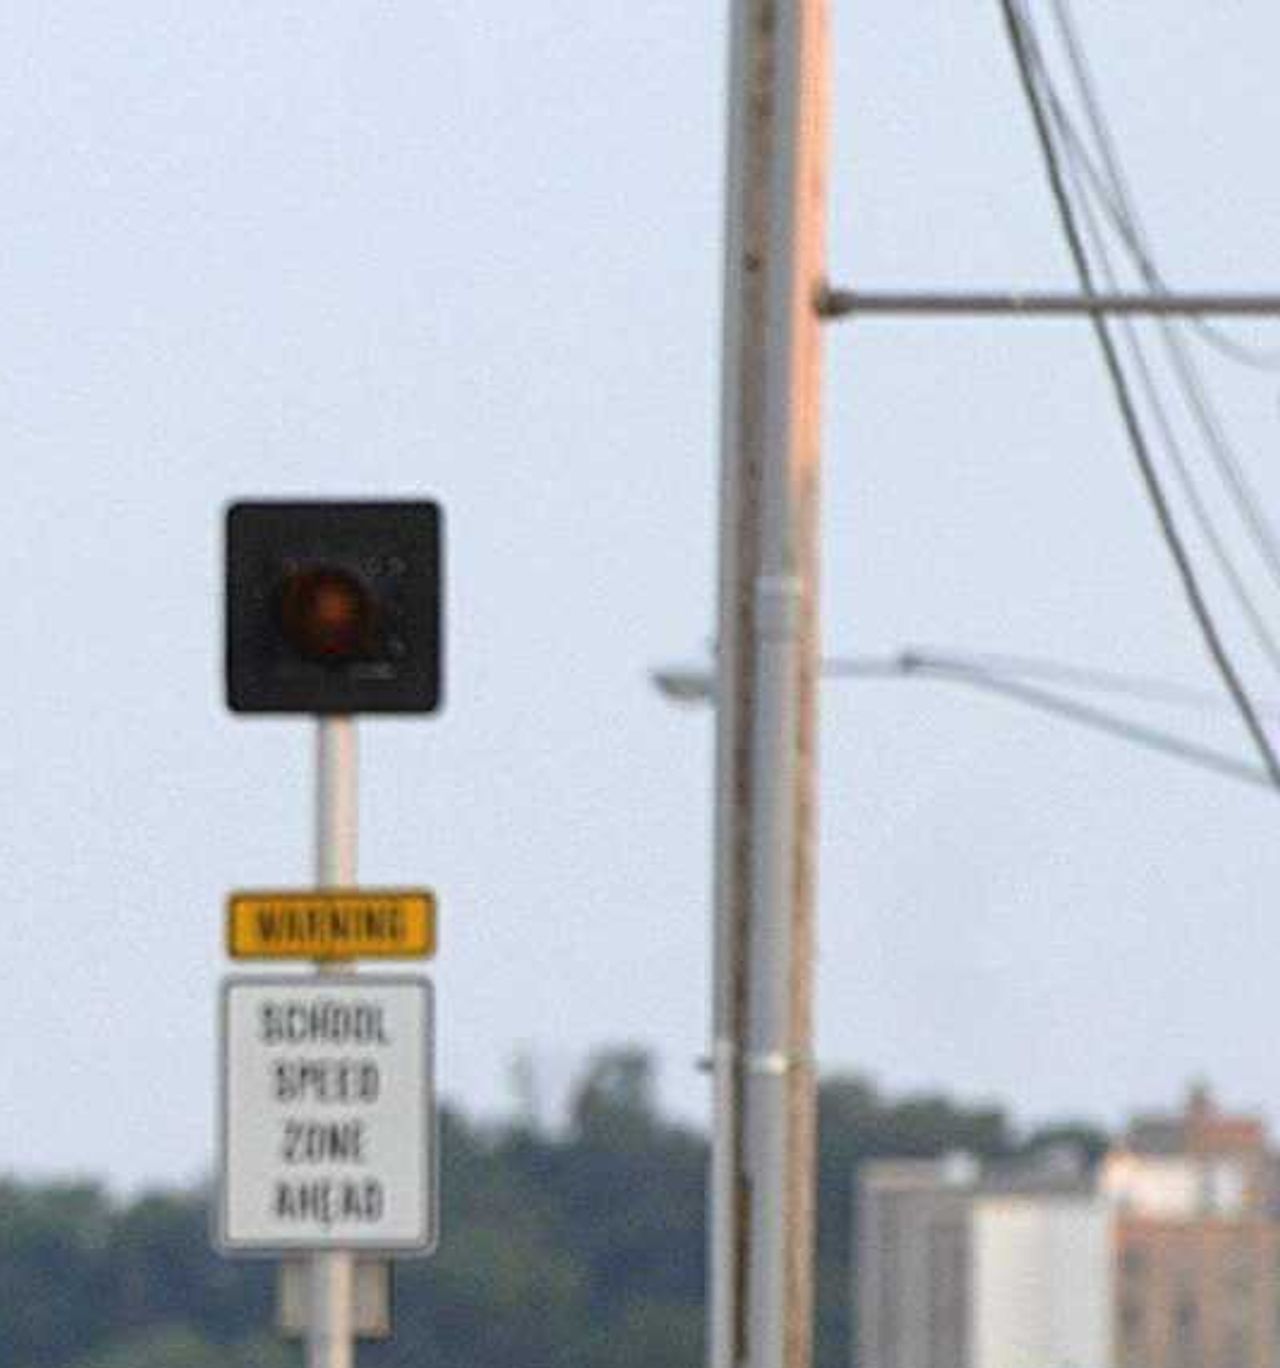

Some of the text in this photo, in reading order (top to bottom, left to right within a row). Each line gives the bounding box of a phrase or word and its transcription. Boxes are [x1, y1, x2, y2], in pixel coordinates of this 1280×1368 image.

[256, 908, 405, 943] WARNING
[259, 1000, 389, 1045] SCHOOL
[273, 1057, 381, 1104] SPEED
[282, 1121, 366, 1165] ZONE
[273, 1178, 384, 1221] AHEAD
